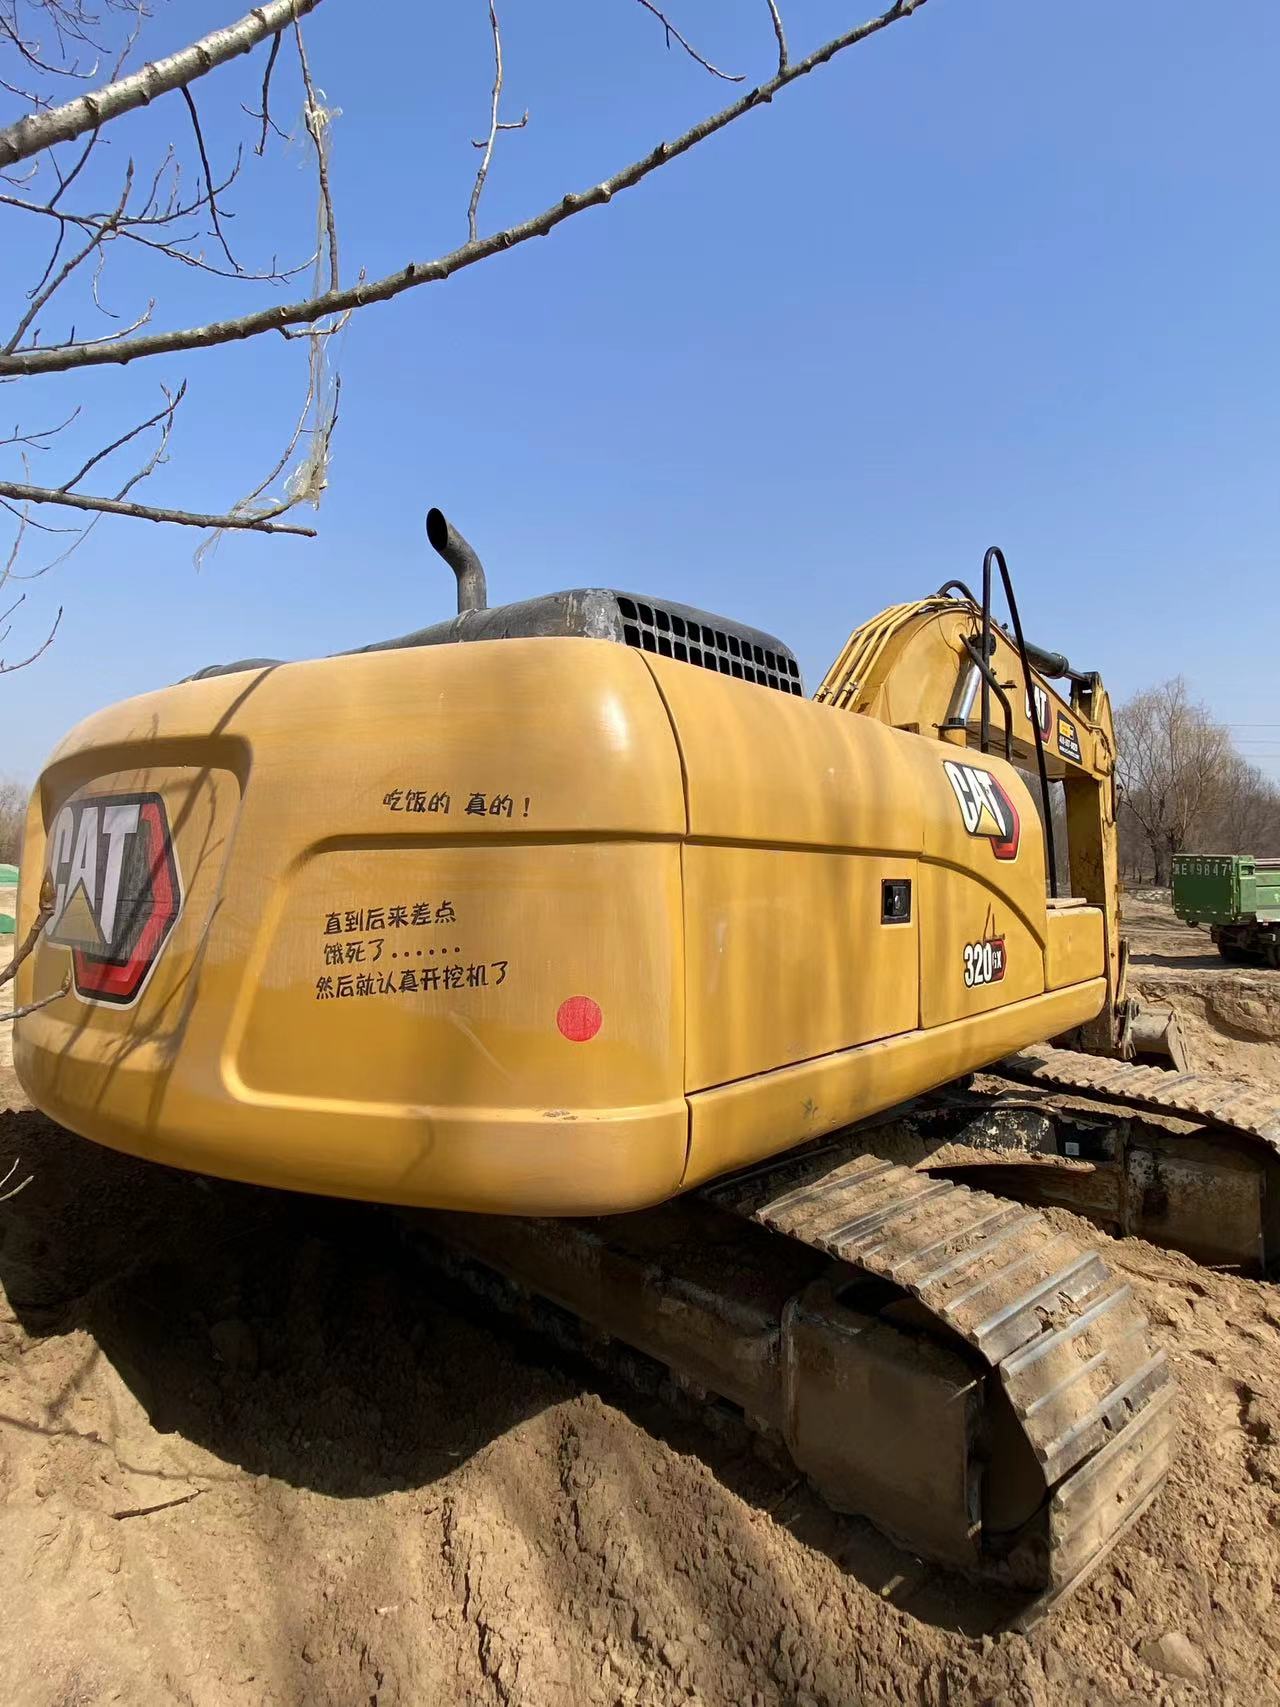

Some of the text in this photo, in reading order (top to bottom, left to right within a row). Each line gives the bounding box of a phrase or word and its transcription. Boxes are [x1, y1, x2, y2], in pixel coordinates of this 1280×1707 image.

[383, 789, 450, 813] 吃饭的
[943, 761, 1007, 837] CAT
[45, 803, 141, 944] CAT
[323, 900, 457, 935] 直到后来差点
[315, 960, 509, 1000] 然后就认真开挖机了
[964, 943, 992, 986] 320
